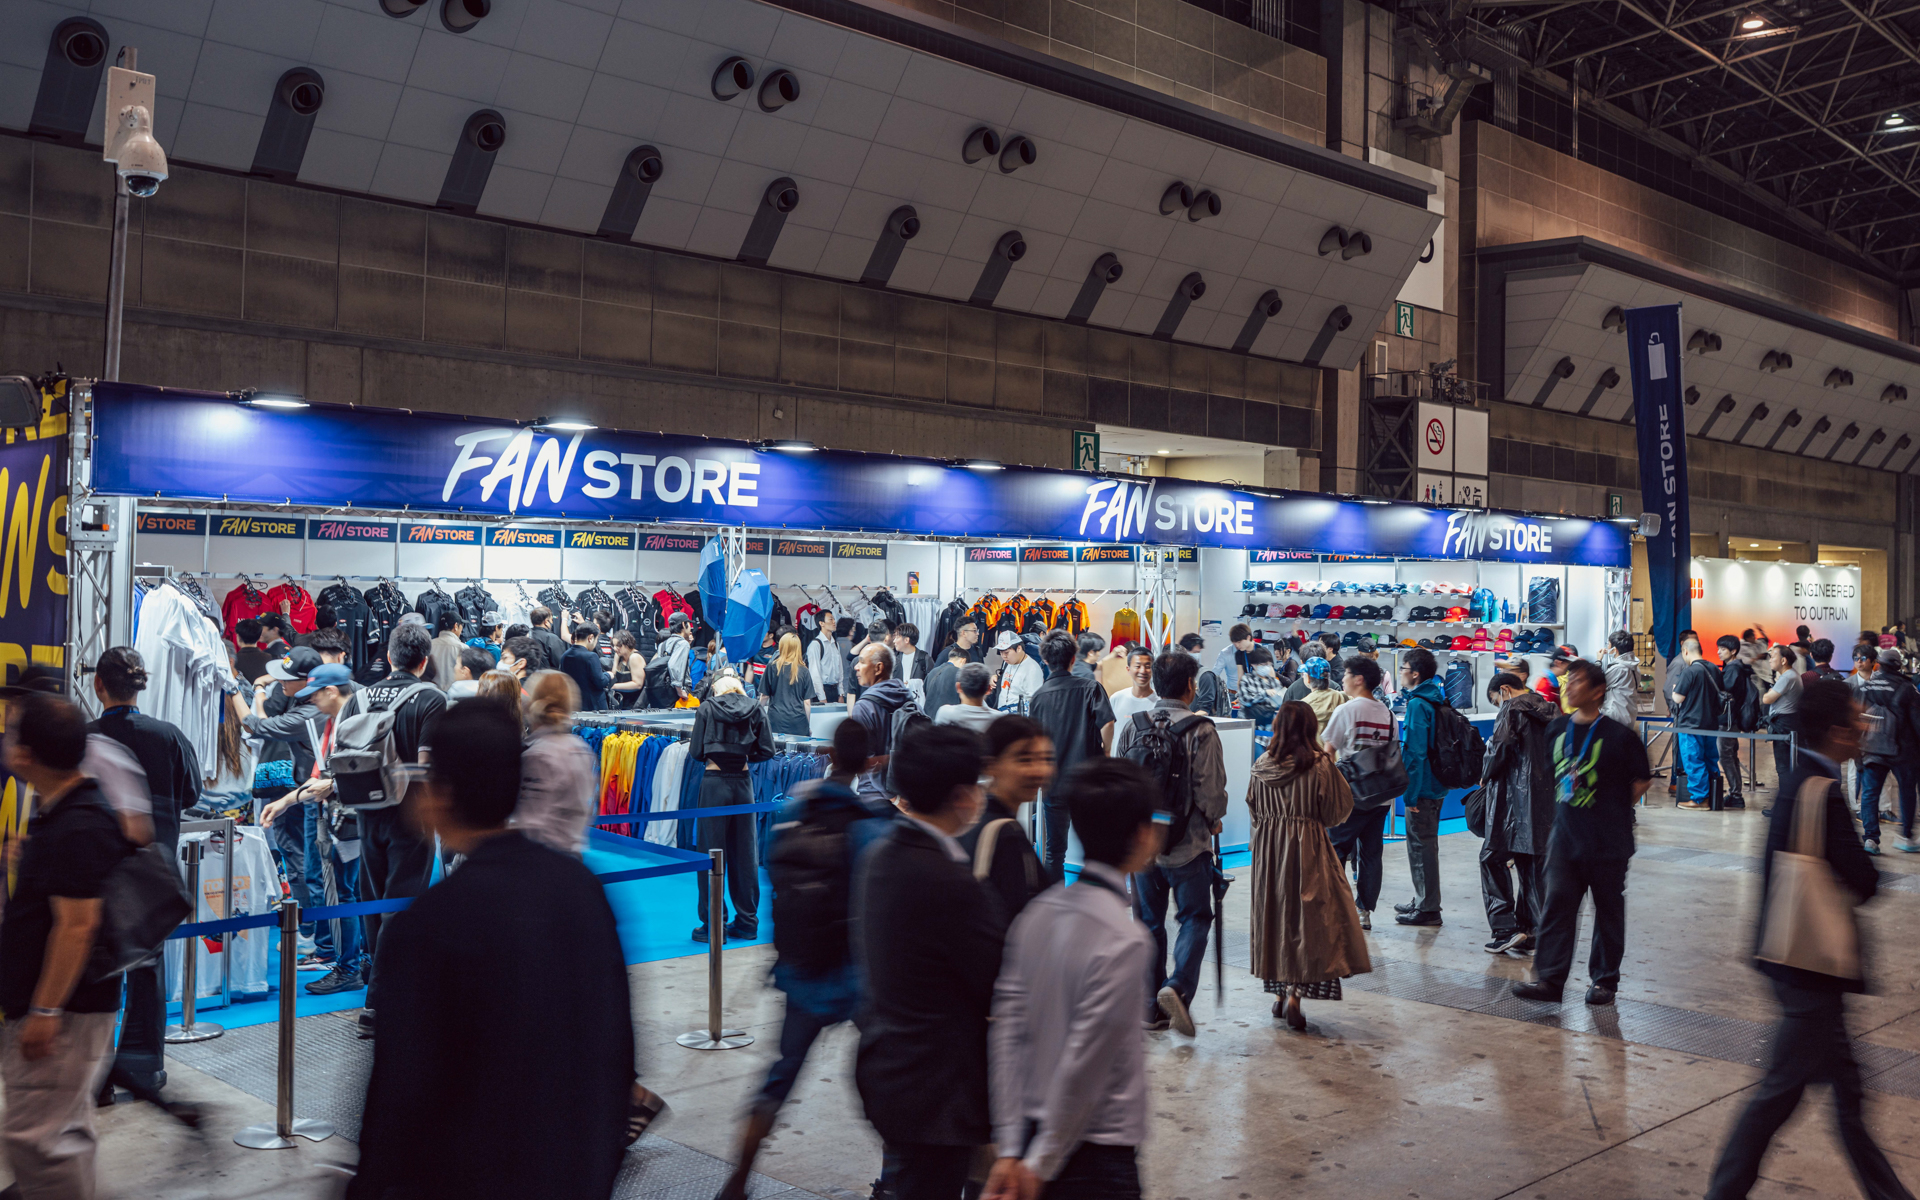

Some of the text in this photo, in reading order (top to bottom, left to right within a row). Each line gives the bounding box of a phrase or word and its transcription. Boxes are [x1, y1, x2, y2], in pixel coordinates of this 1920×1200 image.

[1658, 403, 1676, 495] STORE
[442, 427, 760, 514] FAN STORE
[1079, 478, 1254, 541] FAN STORE
[147, 517, 196, 531] STORE
[219, 517, 296, 535] FAN STORE
[317, 521, 389, 539] FAN STORE
[408, 525, 474, 543] FAN STORE
[492, 529, 555, 546] FAN STORE
[571, 531, 629, 548] FAN STORE
[1442, 509, 1553, 558] FAN STORE
[644, 535, 668, 550] FAN
[666, 538, 699, 549] STORE
[737, 541, 764, 551] ORE
[777, 541, 825, 555] FAN STORE
[837, 543, 882, 557] FAN STORE
[970, 547, 1012, 561] FAN STORE
[1024, 547, 1069, 561] FAN STORE
[1081, 547, 1129, 561] FAN STORE
[1164, 550, 1192, 559] STRE
[1256, 550, 1312, 562] FAN STORE
[1690, 578, 1704, 599] BB
[1794, 582, 1855, 598] ENGINEERED
[1794, 606, 1848, 621] TO OUTRUN
[366, 687, 419, 700] NISS
[204, 878, 245, 892] TOO
